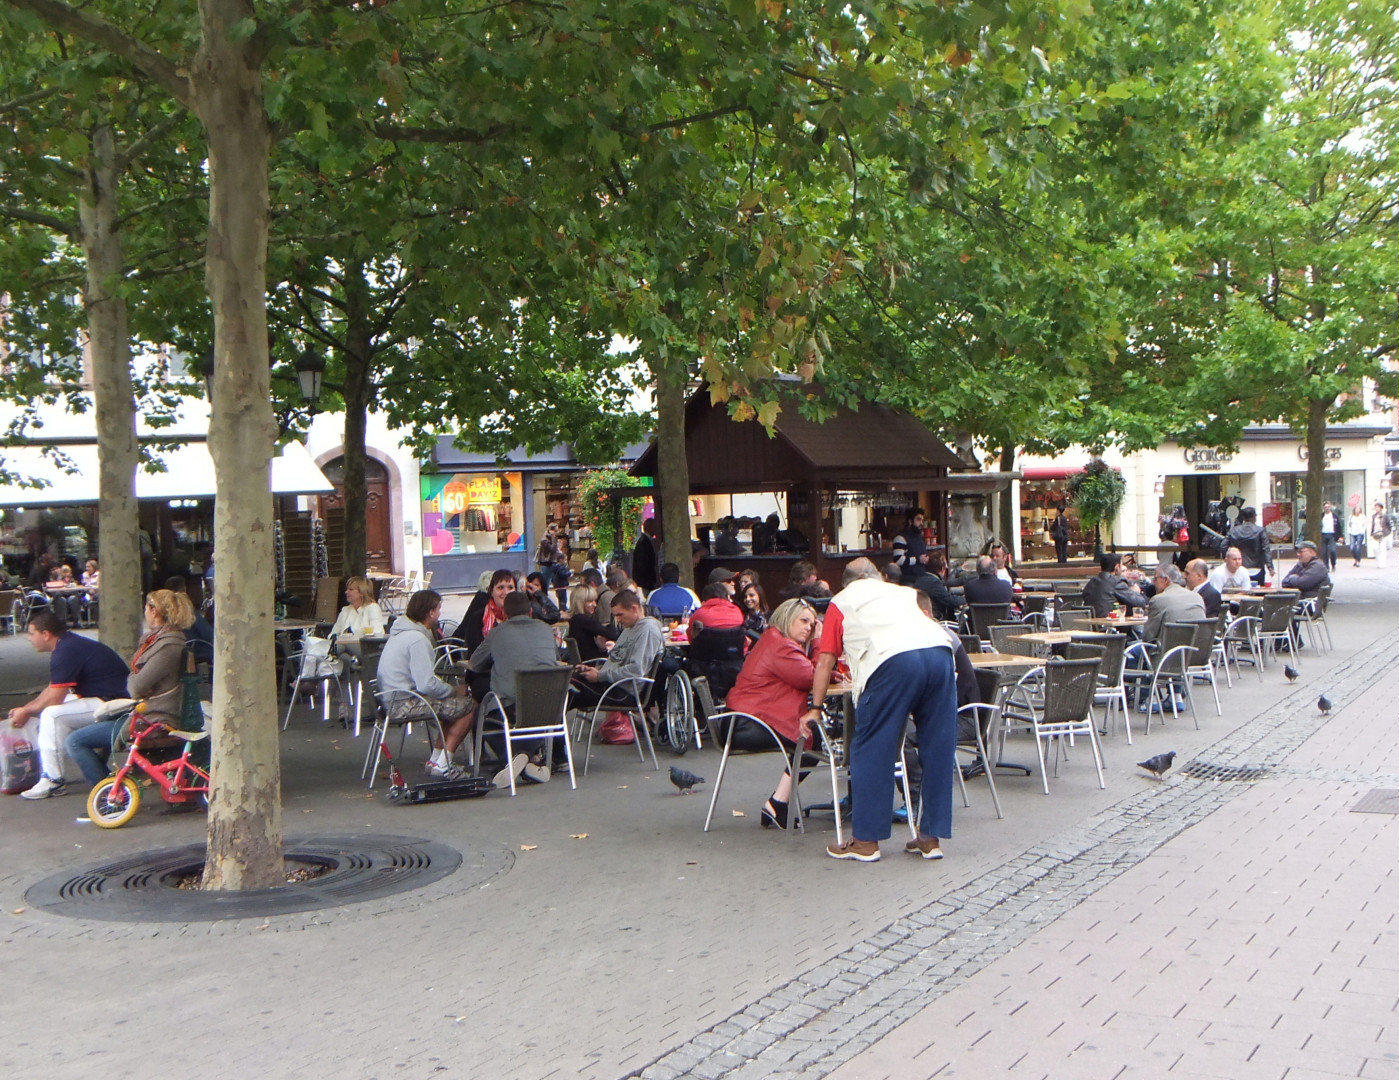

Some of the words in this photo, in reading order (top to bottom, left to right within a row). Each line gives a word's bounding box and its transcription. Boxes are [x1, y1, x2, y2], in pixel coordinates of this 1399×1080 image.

[1184, 446, 1233, 463] GEORGES
[1297, 444, 1342, 460] GGES
[469, 480, 499, 489] FLASH
[470, 490, 498, 498] DAY'Z
